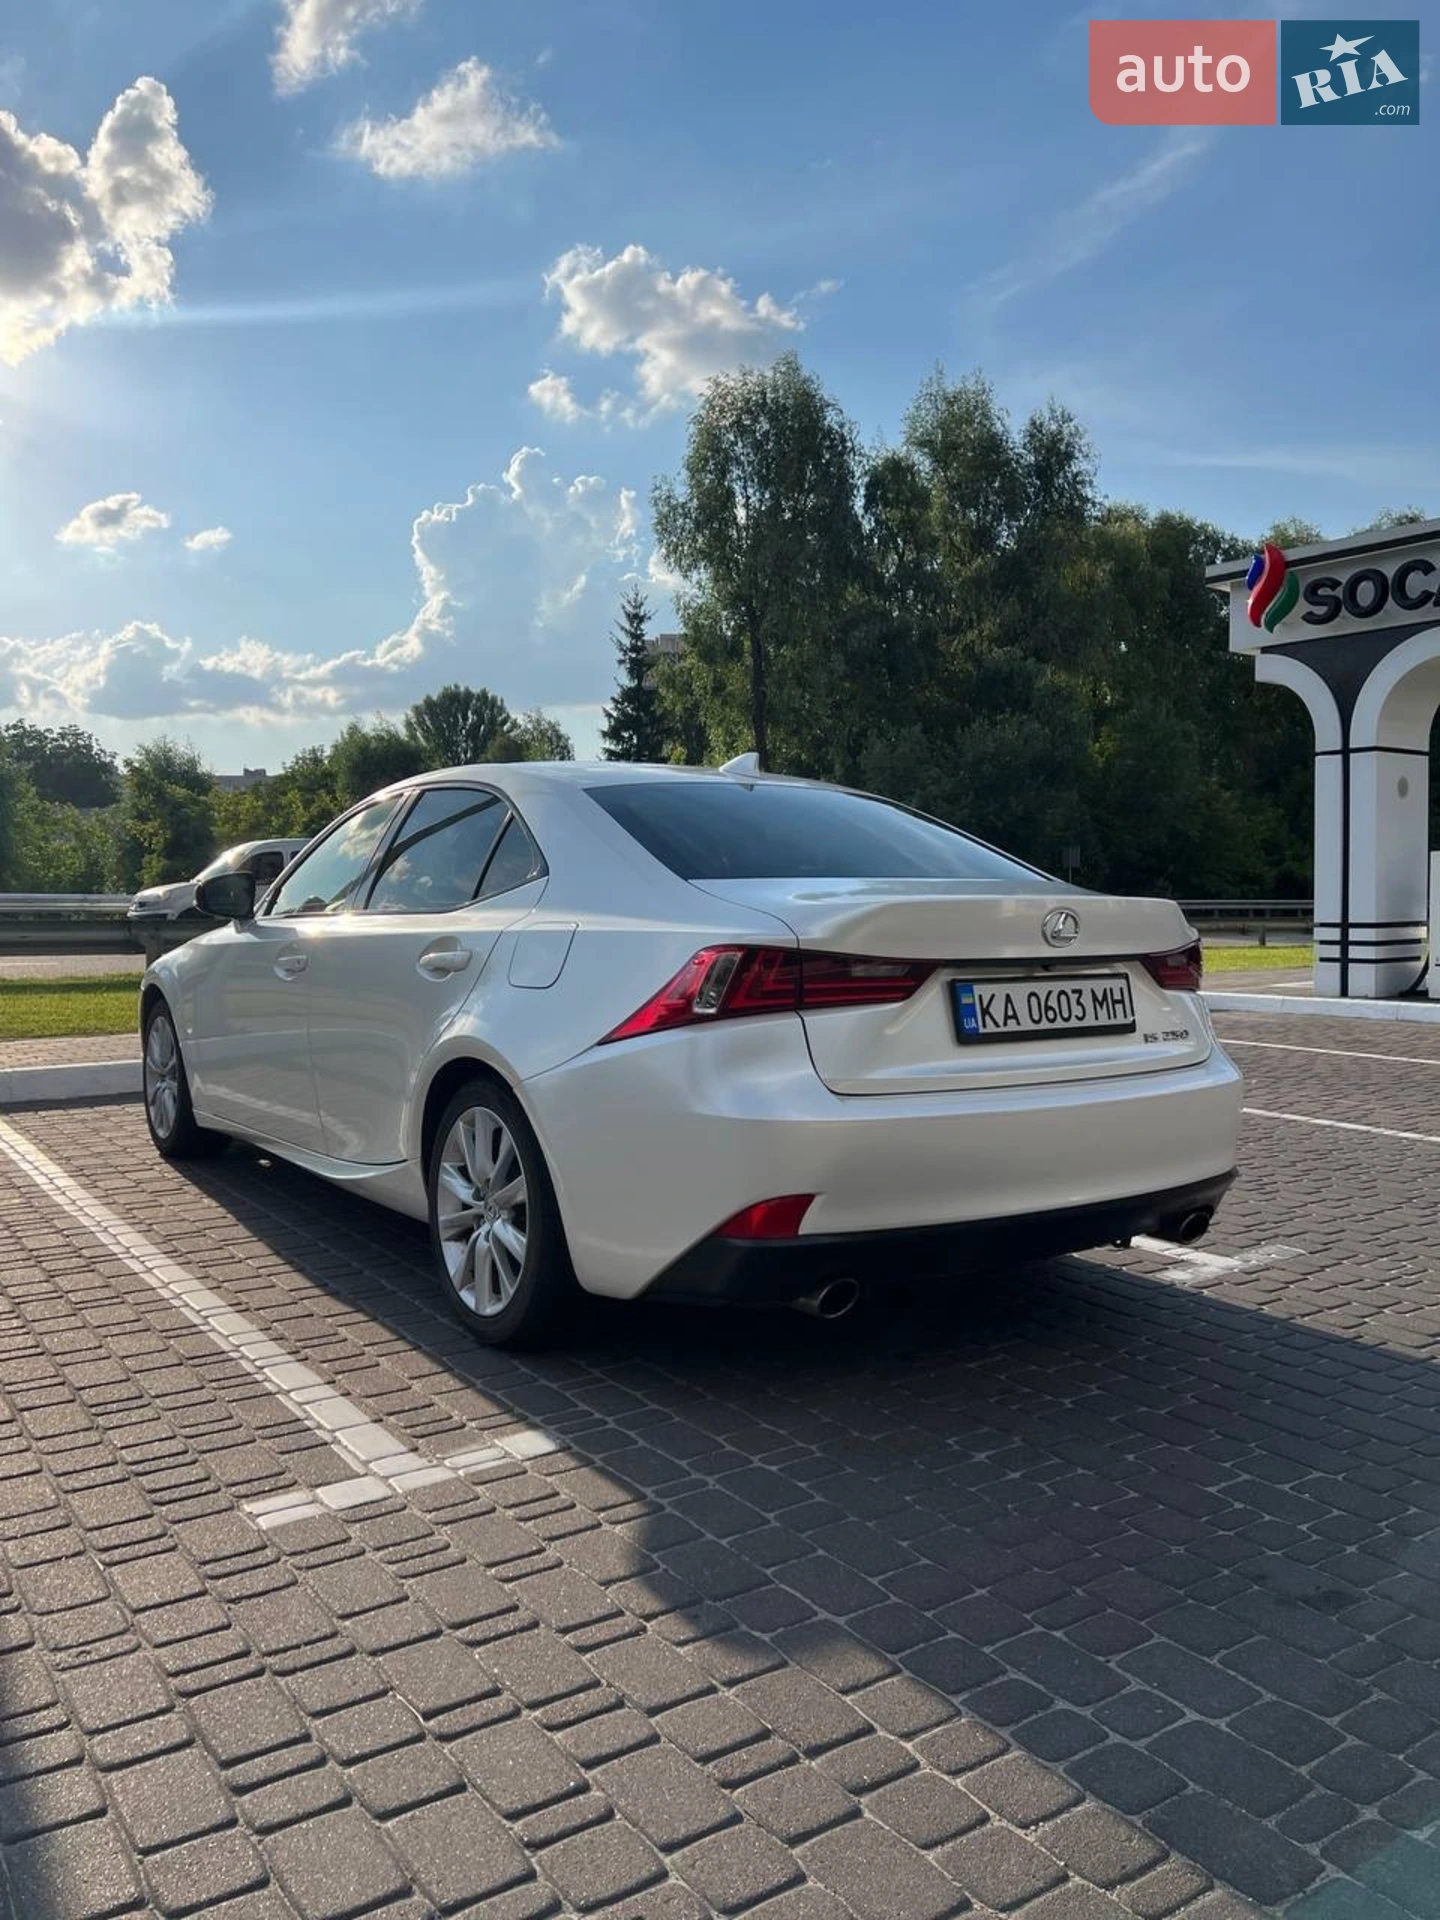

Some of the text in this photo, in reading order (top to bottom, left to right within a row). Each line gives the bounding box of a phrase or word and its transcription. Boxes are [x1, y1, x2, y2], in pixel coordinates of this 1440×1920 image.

[1301, 558, 1440, 625] SOC
[963, 1017, 978, 1029] UA
[978, 986, 1128, 1029] KA 0603 MH
